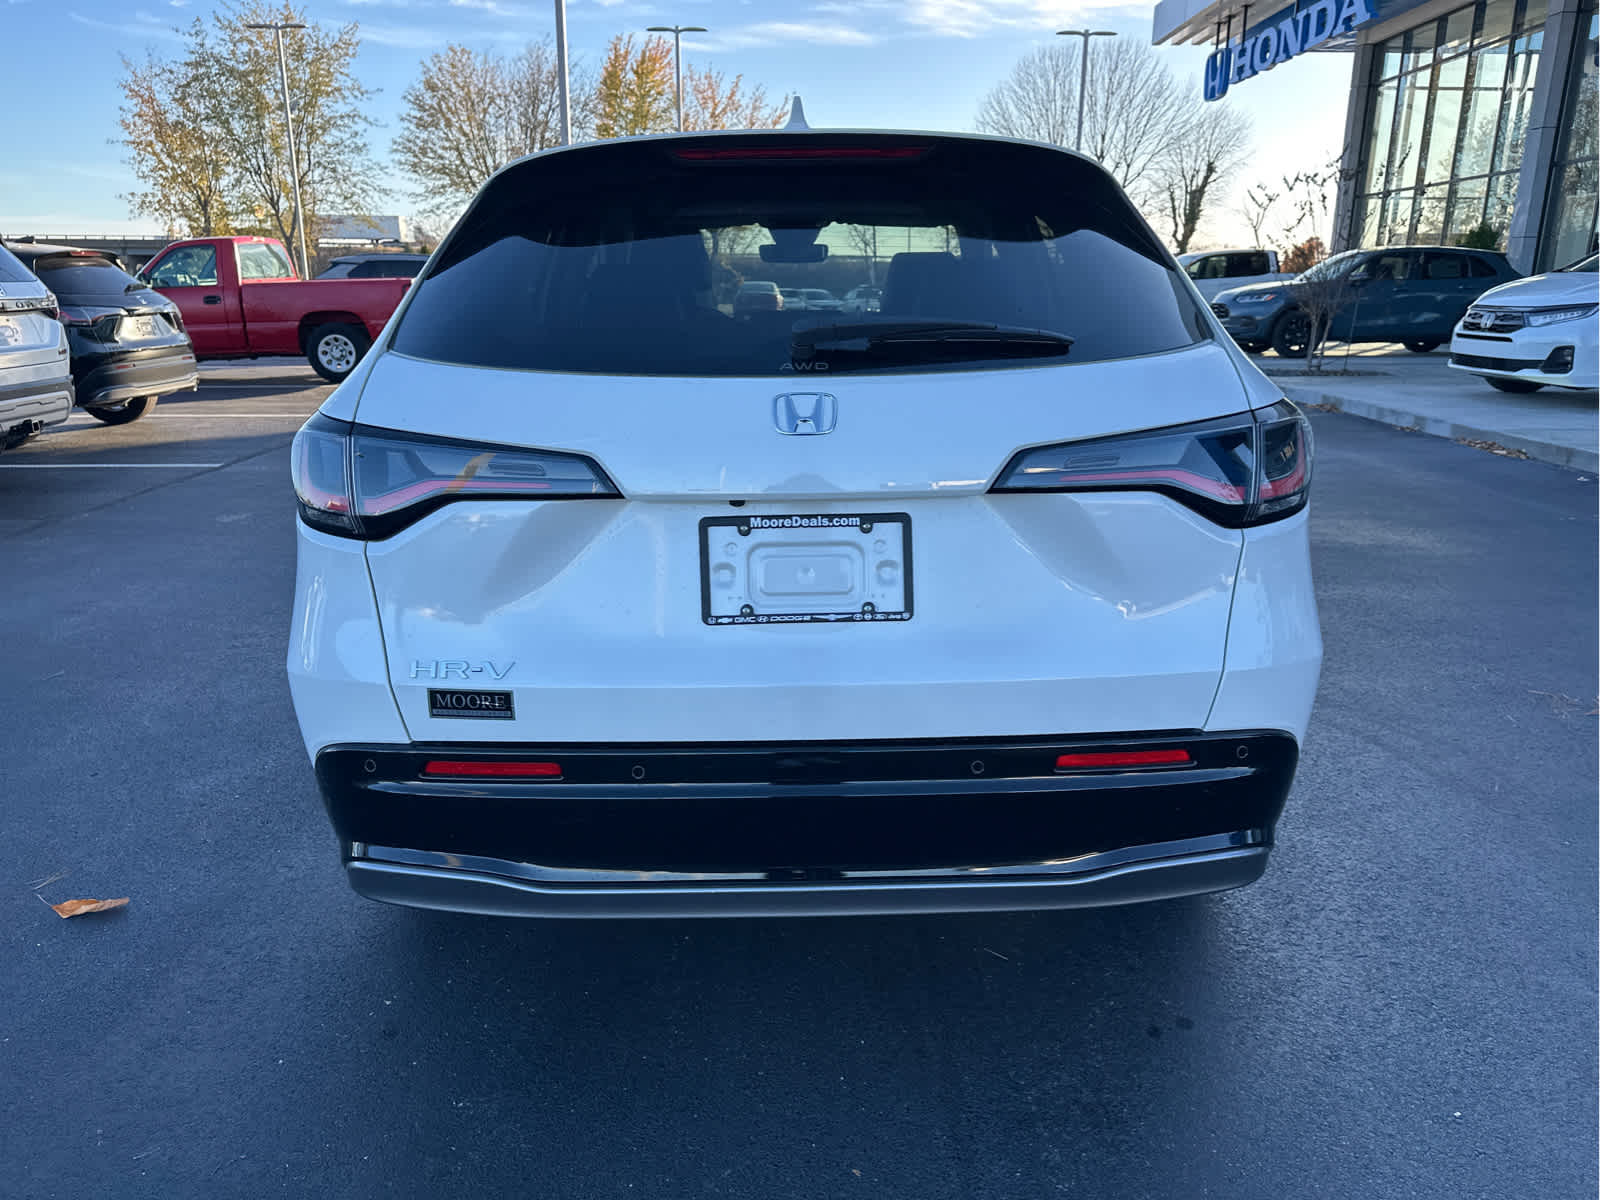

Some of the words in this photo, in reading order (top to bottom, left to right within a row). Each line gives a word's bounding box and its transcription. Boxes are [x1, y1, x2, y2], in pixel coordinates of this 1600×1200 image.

[1230, 0, 1371, 84] HONDA
[779, 362, 829, 370] AWD
[750, 516, 860, 528] MooreDeals.com
[408, 659, 516, 680] HR-V
[435, 693, 506, 709] MOORE
